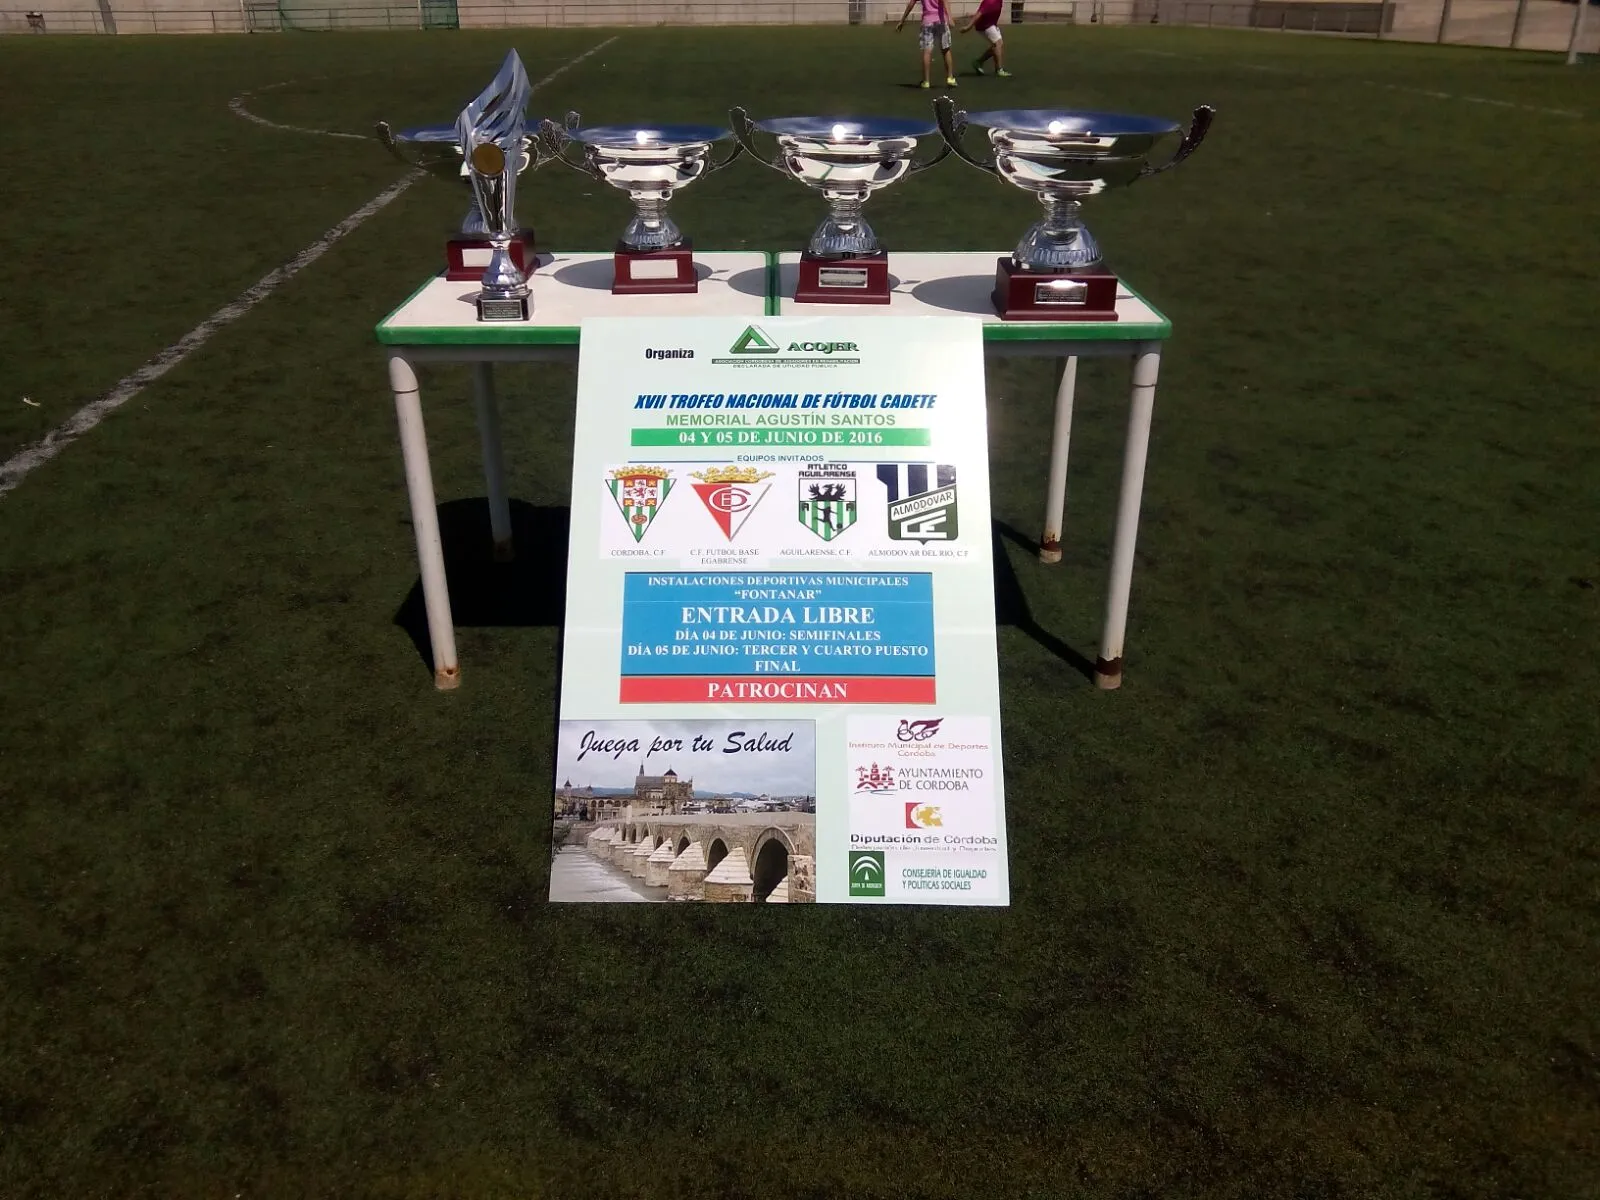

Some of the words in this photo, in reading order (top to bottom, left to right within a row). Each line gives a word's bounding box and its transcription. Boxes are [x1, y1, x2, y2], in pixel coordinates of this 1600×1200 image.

[787, 341, 860, 354] ACOJER
[645, 348, 694, 360] Organiza
[634, 394, 667, 409] XVII
[669, 394, 725, 409] TROFEO
[725, 394, 799, 409] NACIONAL
[801, 394, 822, 409] DE
[822, 391, 878, 409] FÚTBOL
[880, 394, 937, 409] CADETE
[666, 414, 751, 426] MEMORIAL
[755, 411, 826, 426] AGUSTÍN
[831, 414, 896, 426] SANTOS
[679, 431, 696, 443] 04
[701, 431, 712, 443] Y
[716, 431, 733, 443] 05
[738, 431, 760, 443] DE
[764, 431, 817, 443] JUNIO
[822, 431, 845, 443] DE
[849, 431, 883, 443] 2016
[893, 491, 953, 517] ALMODOVAR
[738, 548, 760, 556] BASE
[868, 549, 921, 557] ALMODOVAR
[921, 549, 937, 557] DEL
[701, 557, 748, 565] EGABRENSE
[648, 576, 744, 586] INSTALACIONES
[747, 576, 823, 586] DEPORTIVAS
[826, 576, 909, 586] MUNICIPALES
[682, 607, 796, 624] ENTRADA
[803, 607, 875, 624] LIBRE
[675, 628, 699, 640] DÍA
[702, 630, 715, 640] 04
[719, 630, 737, 640] DE
[740, 630, 786, 640] JUNIO:
[789, 630, 881, 641] SEMIFINALES
[628, 642, 651, 655] DÍA
[655, 645, 668, 655] 05
[672, 645, 690, 655] DE
[693, 645, 739, 655] JUNIO:
[743, 645, 798, 655] TERCER
[802, 645, 811, 655] Y
[814, 645, 872, 656] CUARTO
[875, 645, 928, 656] PUESTO
[755, 661, 801, 671] FINAL
[707, 682, 848, 698] PATROCINAN
[577, 730, 640, 761] Juega
[646, 735, 683, 758] por
[692, 734, 714, 752] tu
[722, 731, 794, 754] Salud
[887, 742, 931, 750] Municipal
[947, 742, 989, 751] Deportes
[898, 768, 983, 779] AYUNTAMIENTO
[899, 780, 912, 789] DE
[850, 833, 921, 844] Diputación
[923, 835, 940, 844] de
[942, 868, 952, 878] DE
[953, 869, 987, 879] IGUALDAD
[902, 881, 907, 889] Y
[940, 881, 972, 890] SOCIALES
